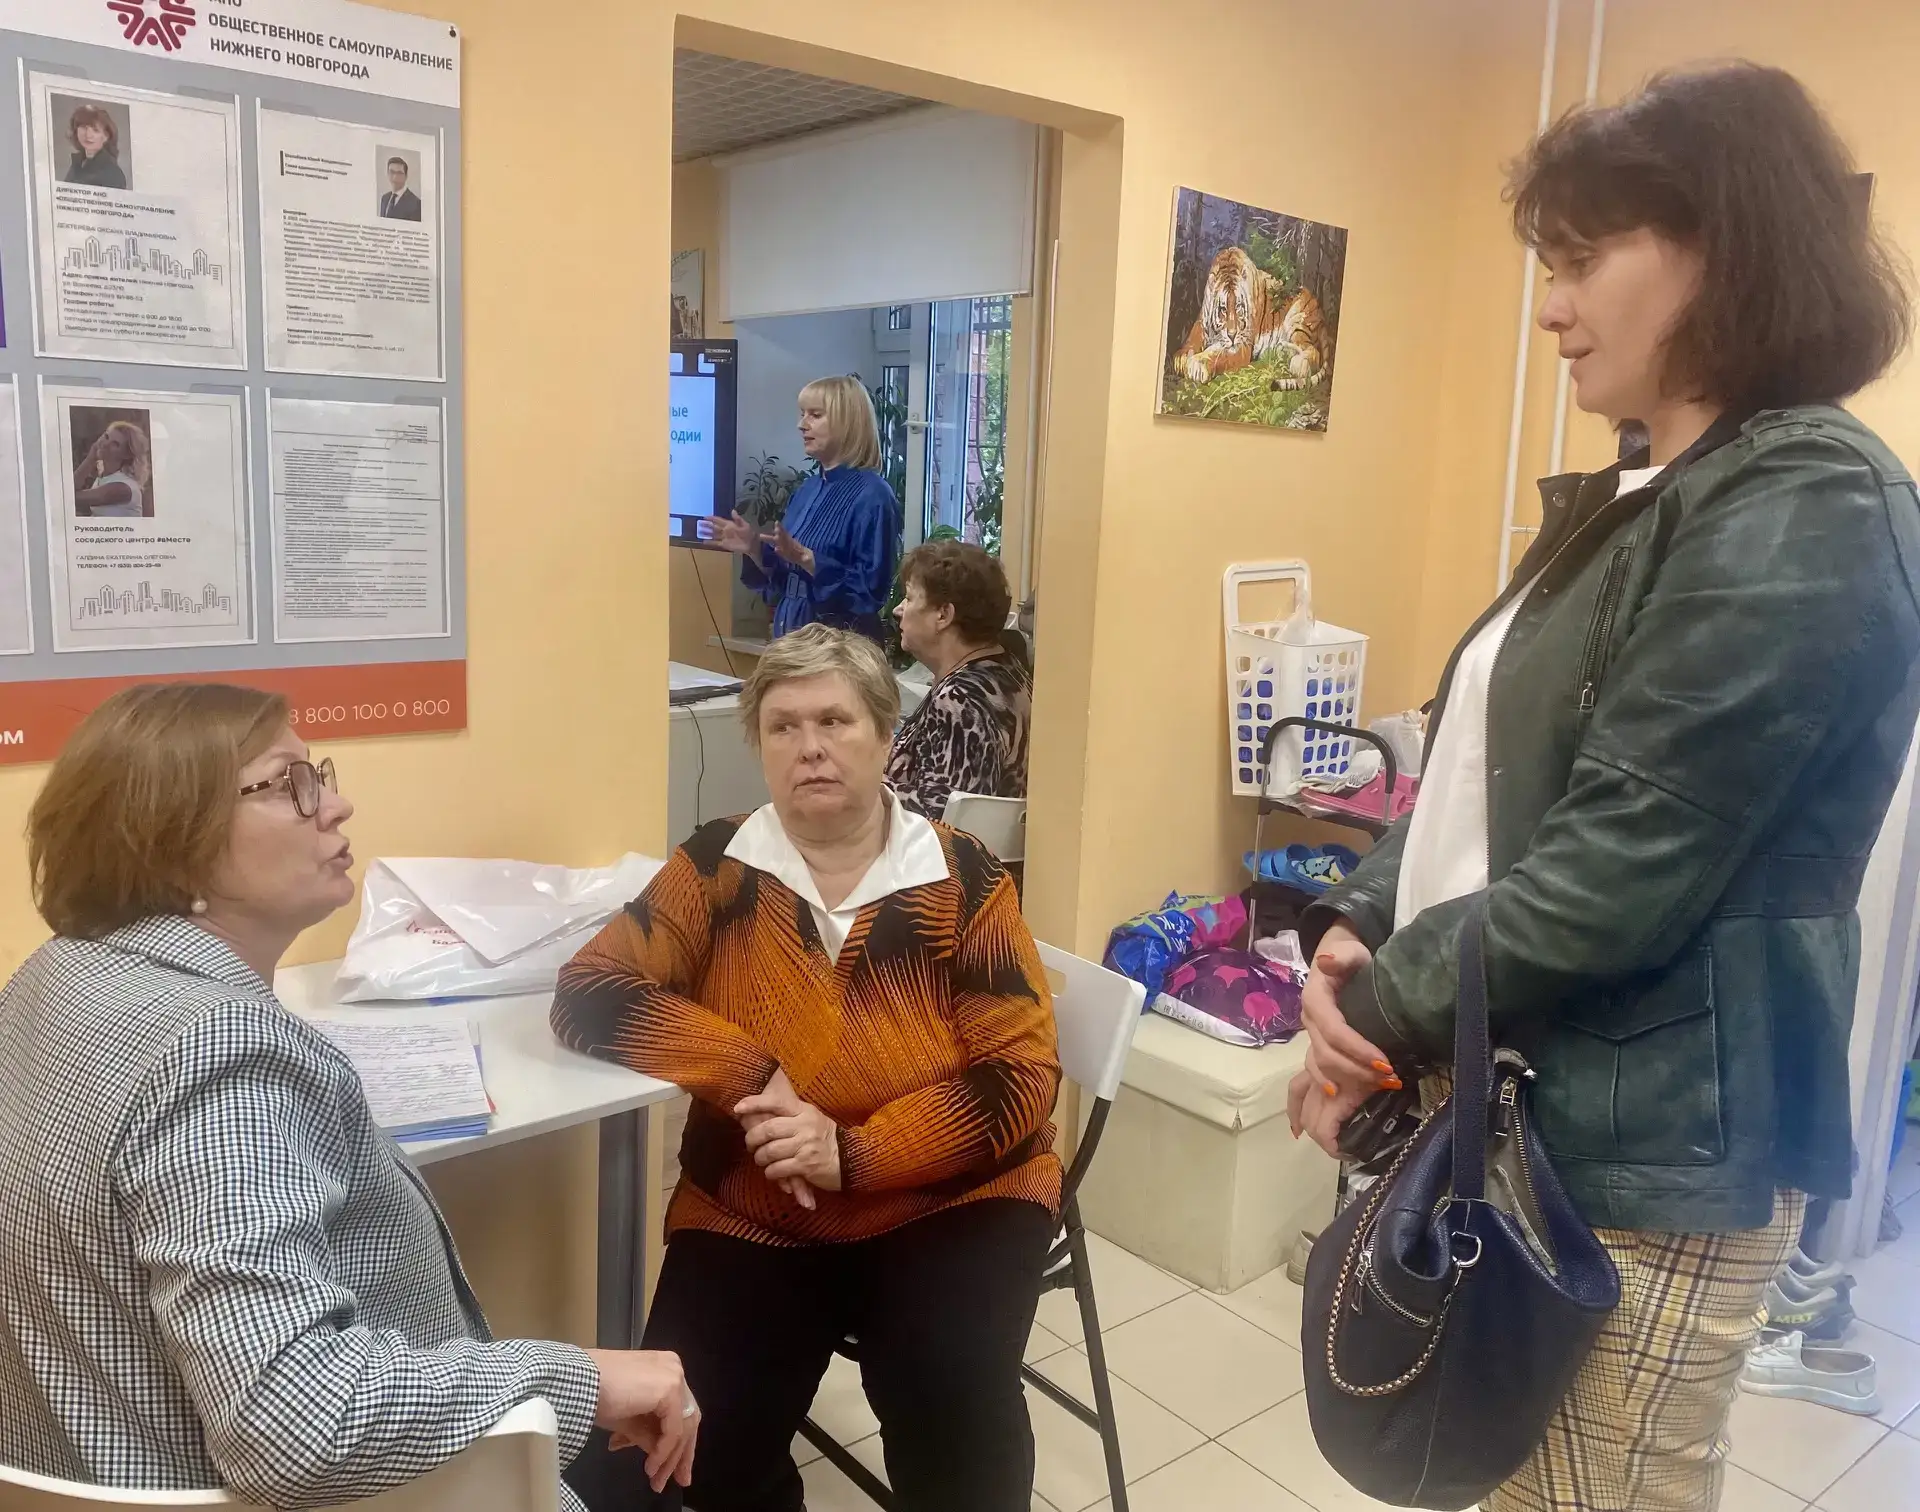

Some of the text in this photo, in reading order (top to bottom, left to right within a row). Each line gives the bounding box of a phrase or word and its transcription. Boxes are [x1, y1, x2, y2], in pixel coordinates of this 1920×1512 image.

[208, 13, 453, 70] ОБЩЕСТВЕННОЕ САМОУПРАВЛЕНИЕ
[210, 37, 370, 79] НИЖНЕГО НОВГОРОДА
[56, 187, 91, 195] ДИРЕКТОР
[669, 406, 689, 418] ые
[74, 525, 135, 533] Руководитель
[288, 699, 450, 724] 8 800 100 0 800
